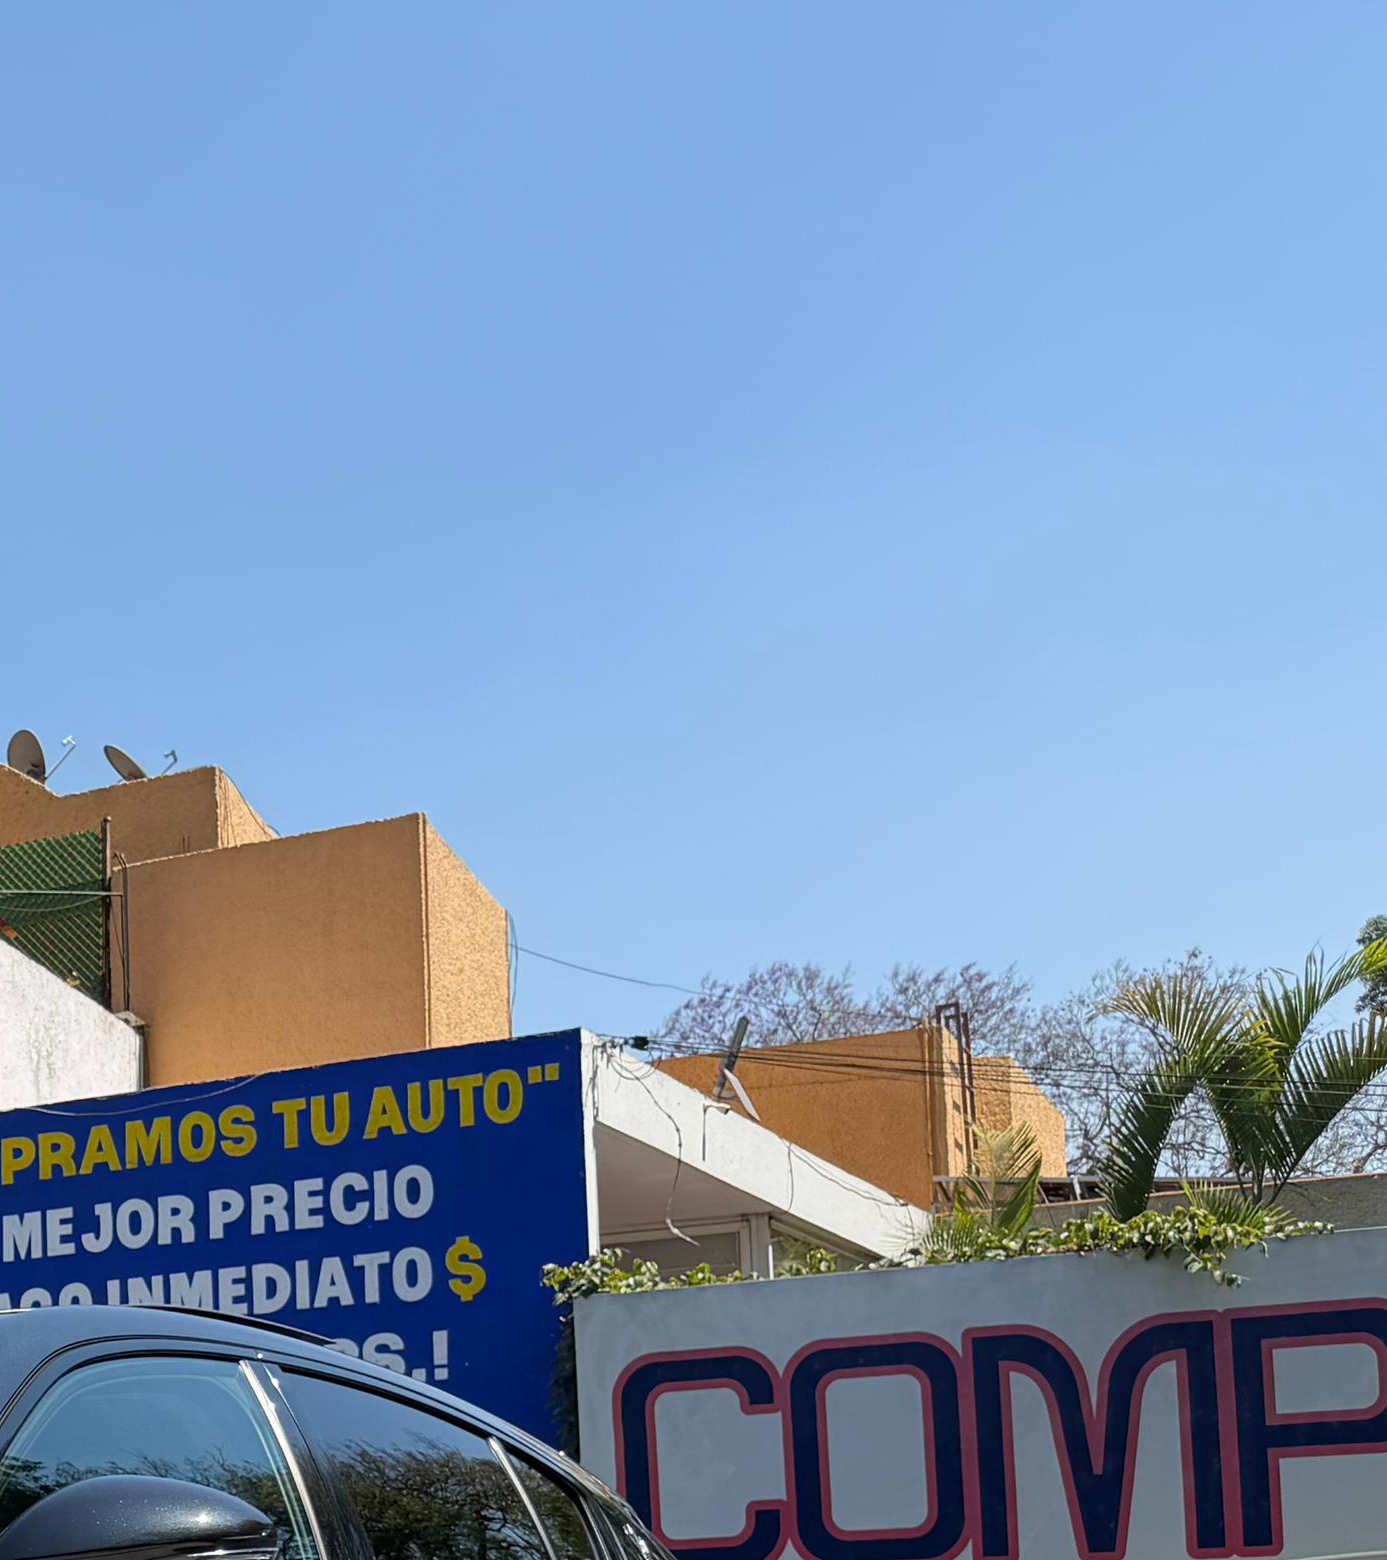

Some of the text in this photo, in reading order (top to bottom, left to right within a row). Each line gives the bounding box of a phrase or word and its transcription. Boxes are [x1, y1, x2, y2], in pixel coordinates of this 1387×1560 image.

[273, 1092, 351, 1149] TU
[363, 1064, 560, 1141] AUTO"
[3, 1193, 195, 1264] MEJOR
[209, 1164, 434, 1240] PRECIO
